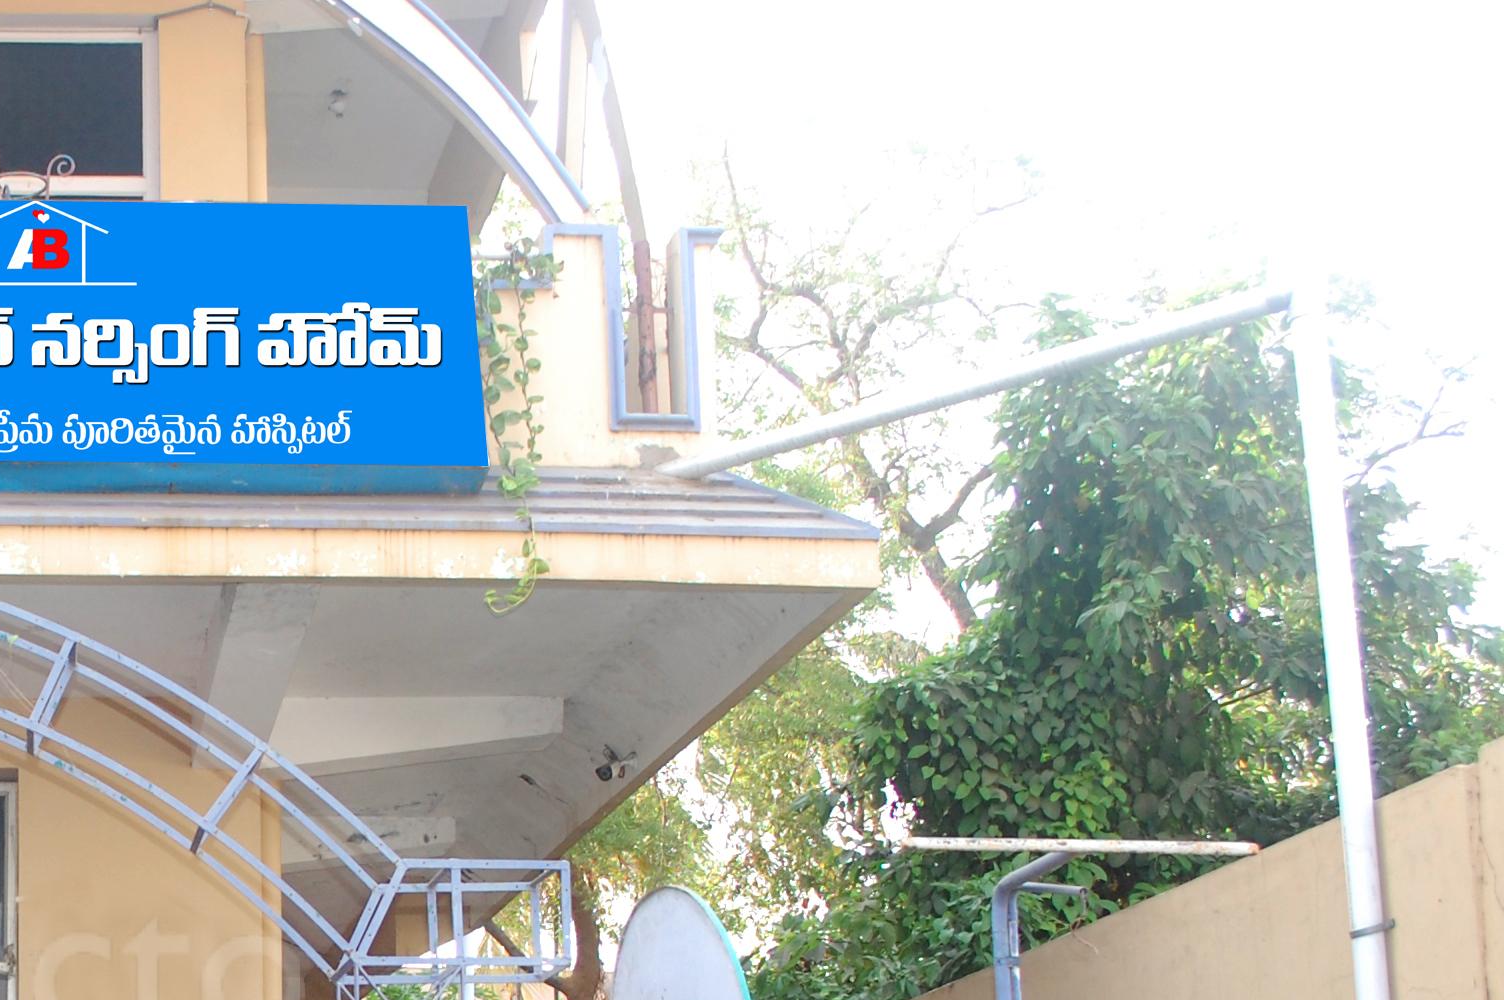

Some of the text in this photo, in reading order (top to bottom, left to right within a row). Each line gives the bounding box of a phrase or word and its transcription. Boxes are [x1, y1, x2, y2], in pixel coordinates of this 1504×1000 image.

[6, 228, 71, 270] AB
[31, 306, 240, 386] నర్సింగ్
[62, 412, 223, 455] పూరితమైన
[229, 409, 354, 454] హాస్పిటల్
